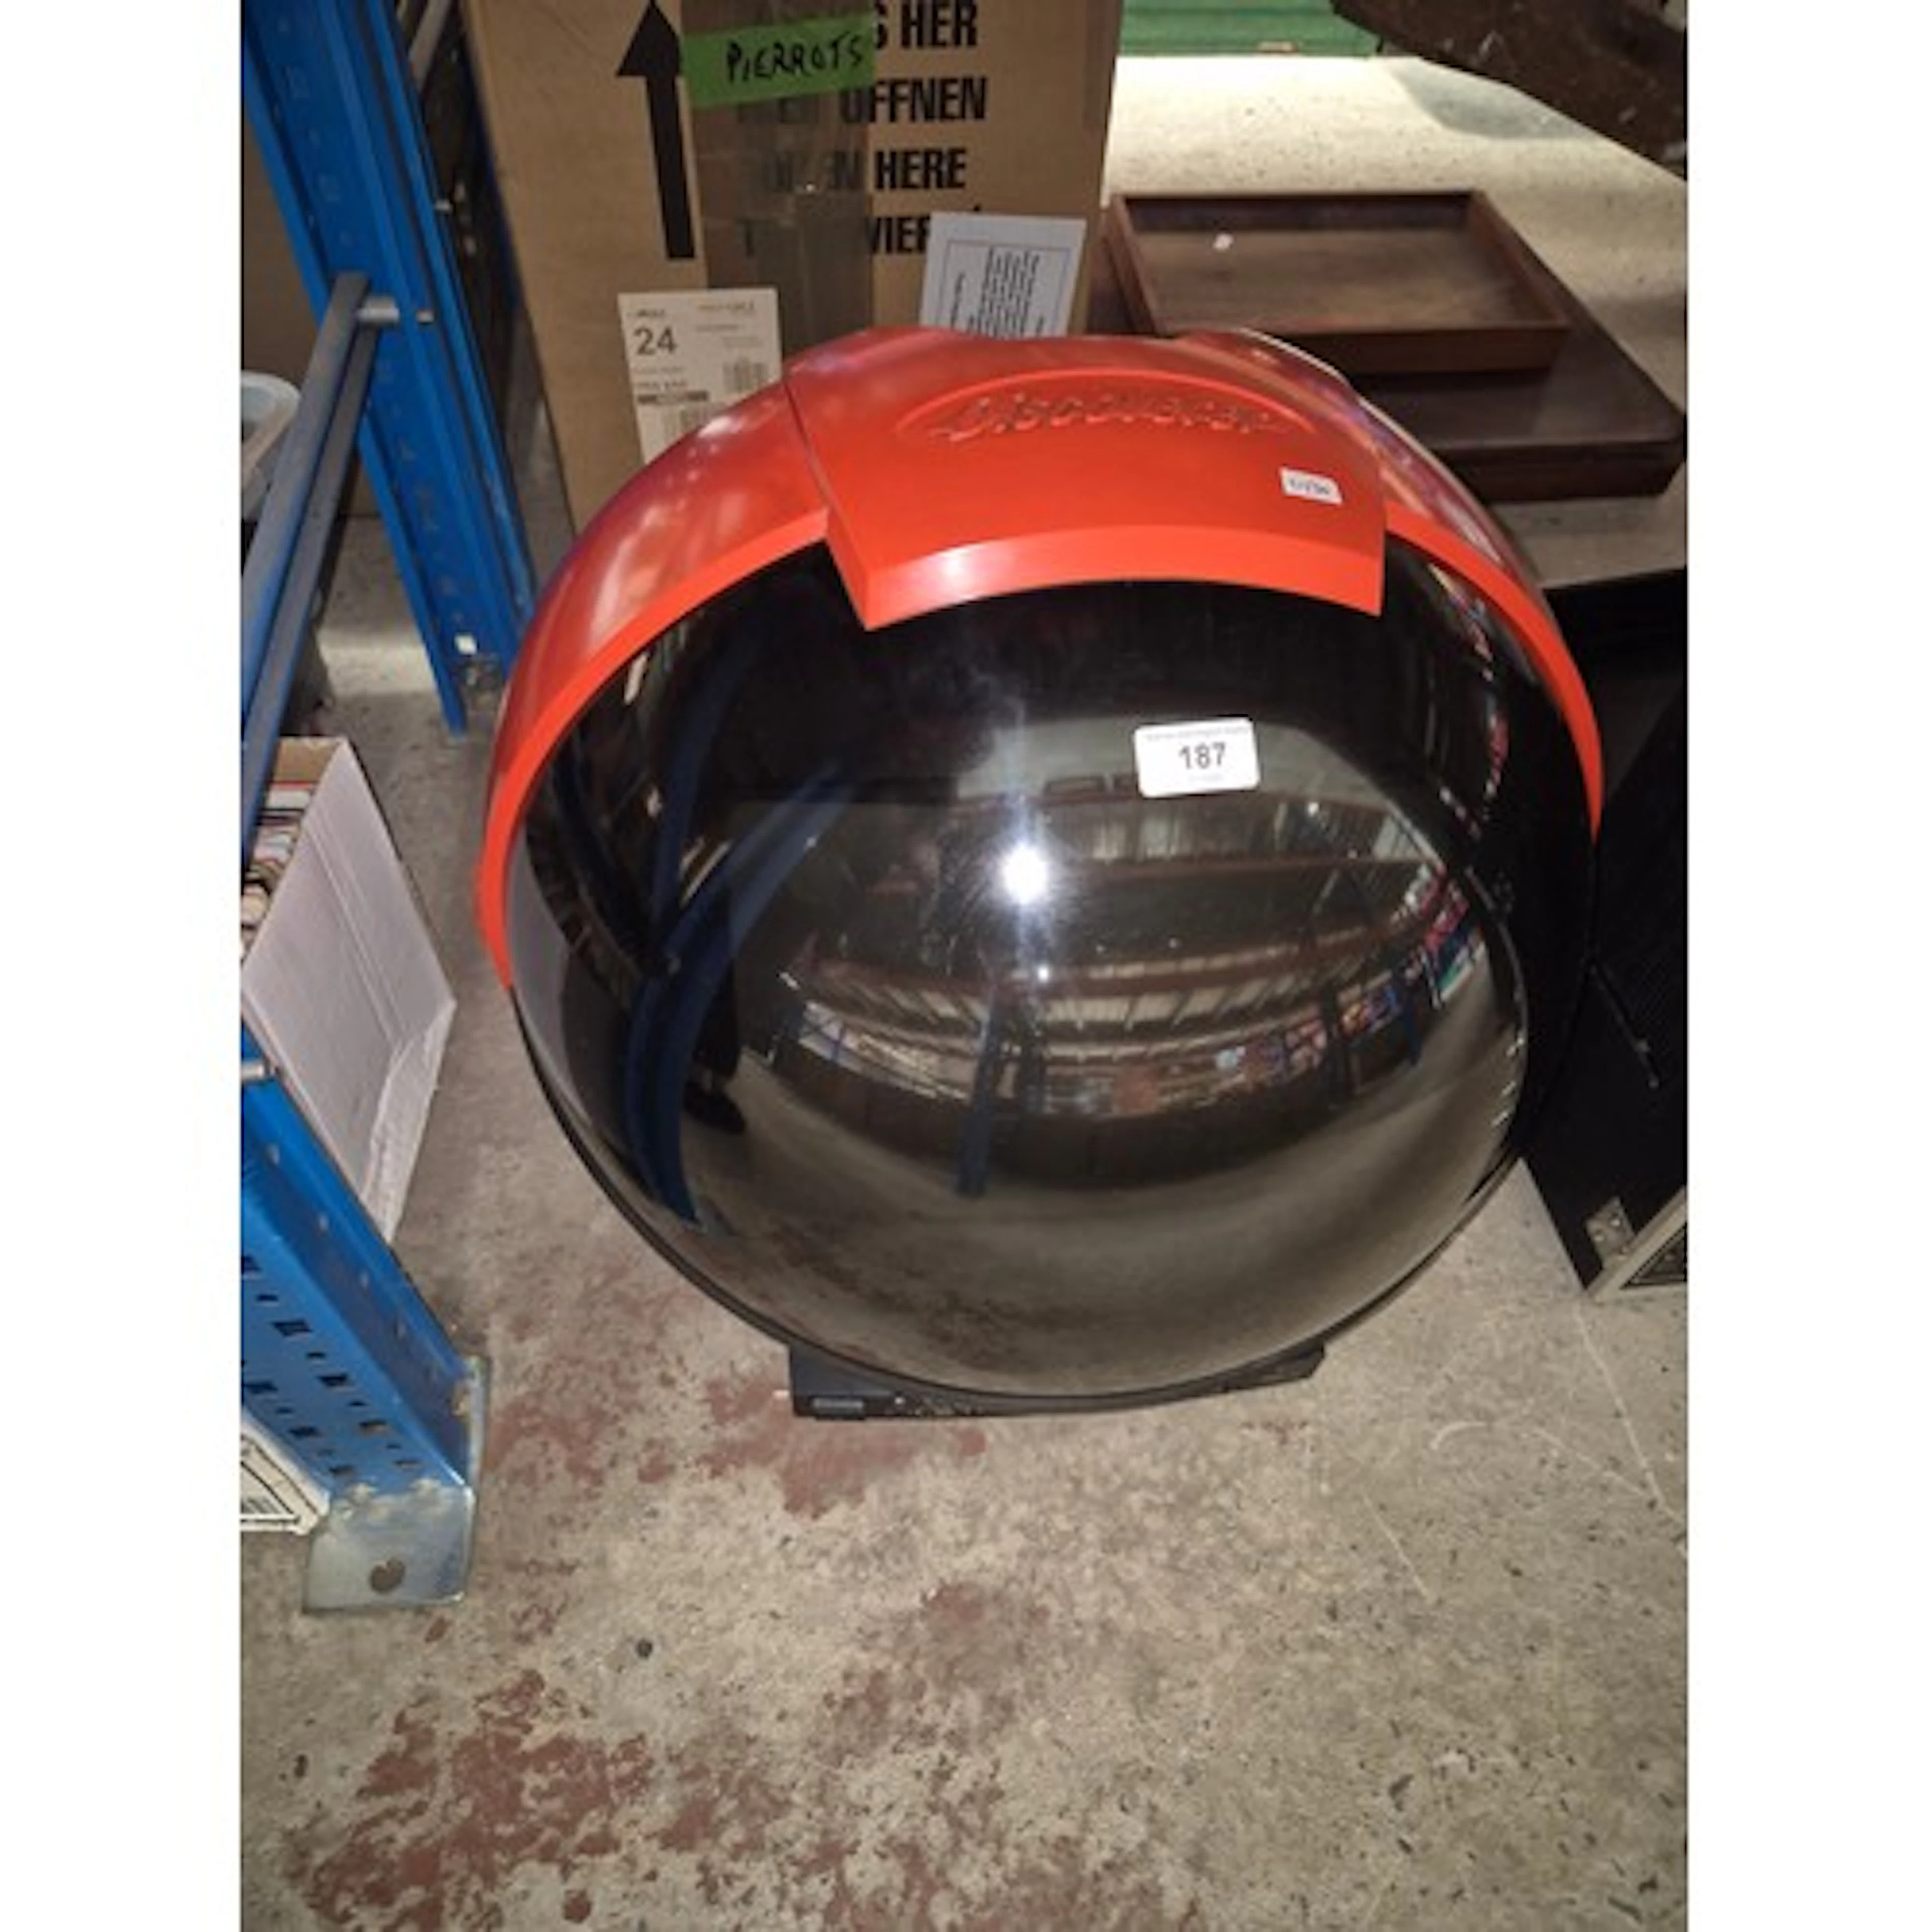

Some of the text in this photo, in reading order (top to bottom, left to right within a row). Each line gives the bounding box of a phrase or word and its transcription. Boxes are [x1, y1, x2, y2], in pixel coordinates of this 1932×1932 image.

[902, 0, 978, 48] HER
[726, 30, 865, 85] PIERROTS
[875, 147, 967, 190] HERE
[633, 326, 678, 355] 24
[1178, 740, 1226, 770] 187
